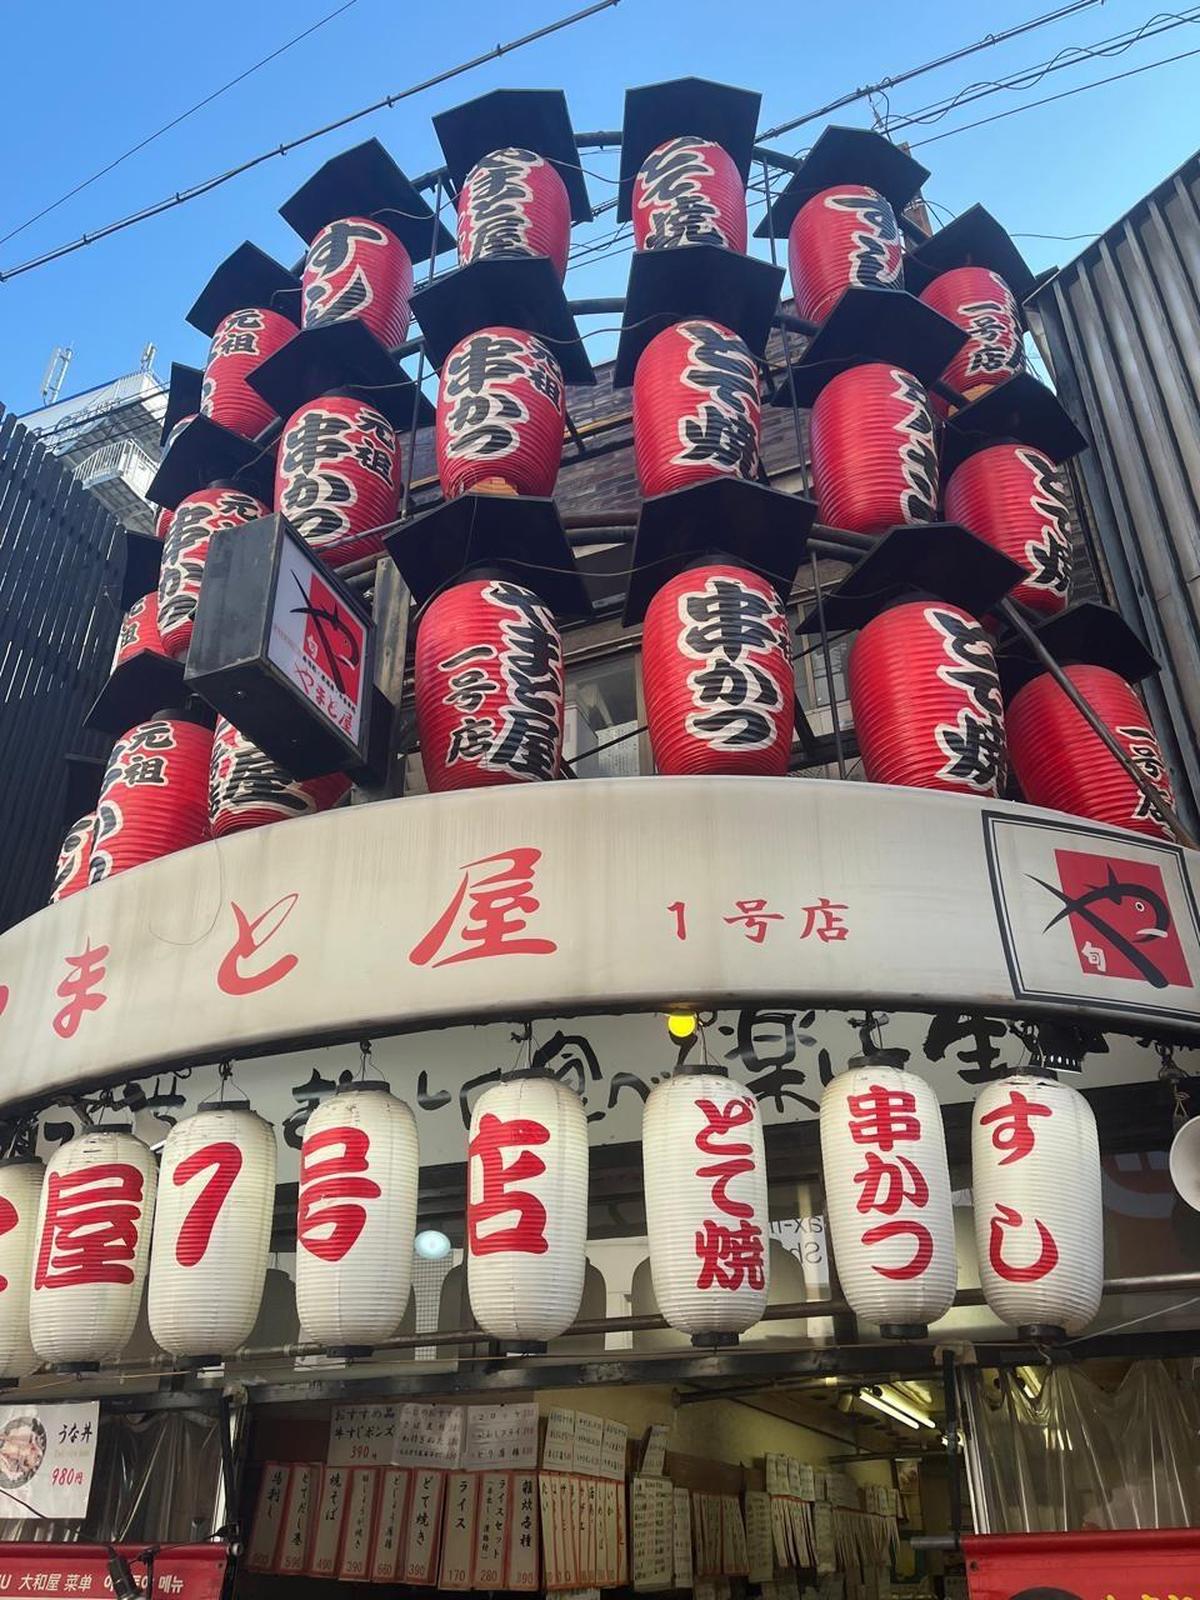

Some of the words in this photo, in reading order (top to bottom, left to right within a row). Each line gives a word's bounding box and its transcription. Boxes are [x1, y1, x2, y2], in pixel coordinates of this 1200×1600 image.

[219, 309, 266, 356] 元祖
[443, 334, 531, 459] 串かつ
[279, 409, 358, 546] 串かつ
[351, 407, 396, 489] 元祖
[676, 576, 784, 751] 串かつ
[438, 643, 499, 767] 一号店
[122, 719, 177, 786] 元祖
[668, 897, 850, 944] 1号店
[35, 1163, 144, 1291] 屋
[297, 1127, 381, 1262] 号
[468, 1113, 551, 1257] 店
[695, 1095, 765, 1292] どて焼
[847, 1085, 930, 1281] 串かつ
[980, 1090, 1059, 1283] すし
[52, 1468, 84, 1485] 980円
[325, 1472, 342, 1521] 焼そば
[416, 1475, 434, 1546] どて焼き
[456, 1480, 469, 1529] ライス
[494, 1479, 506, 1560] ライスセット
[520, 1479, 534, 1548] 雑炊各種
[18, 1573, 62, 1592] 大和屋
[64, 1573, 93, 1592] 菜单
[158, 1574, 184, 1593] 메뉴
[448, 1569, 466, 1582] 170
[480, 1569, 498, 1582] 280
